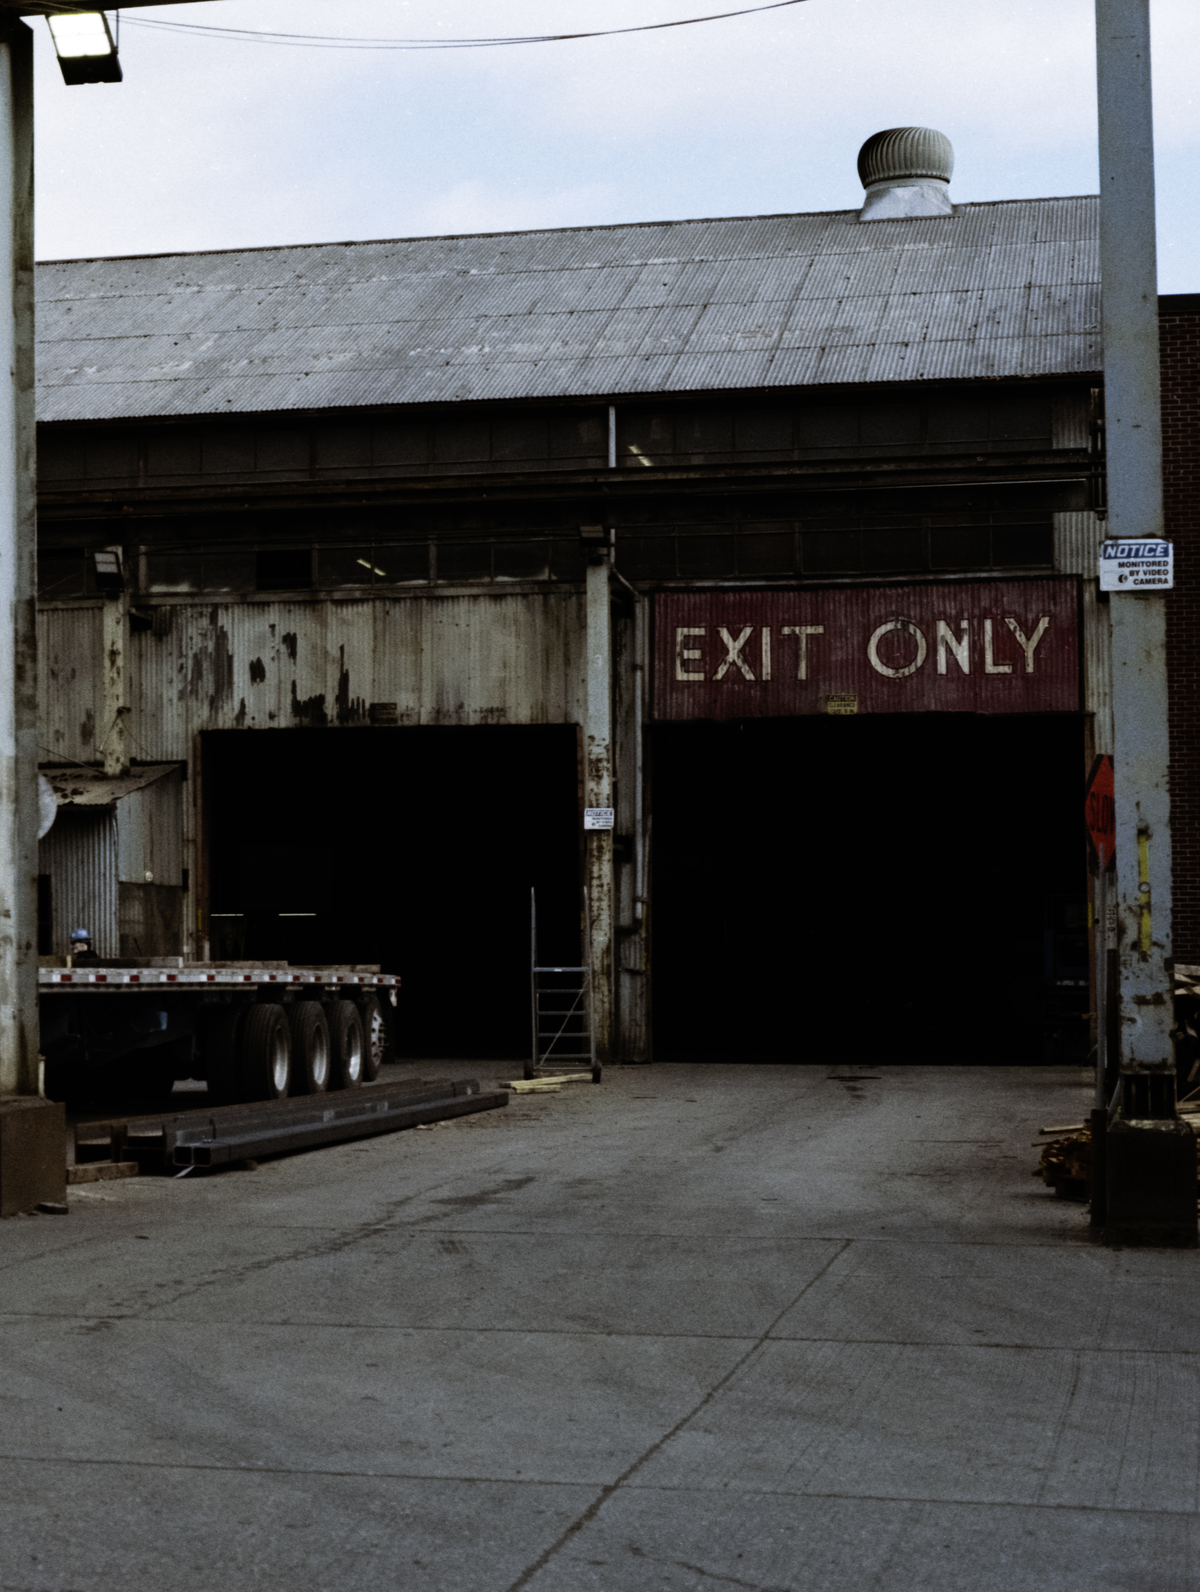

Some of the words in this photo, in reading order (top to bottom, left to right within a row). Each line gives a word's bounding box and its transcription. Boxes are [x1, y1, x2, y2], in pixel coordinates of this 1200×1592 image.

[1105, 543, 1167, 558] NOTICE
[1118, 560, 1169, 568] MONITORED
[1129, 569, 1140, 577] BY
[1142, 568, 1169, 576] VIDEO
[1133, 577, 1169, 586] CAMERA
[675, 623, 825, 682] EXIT
[867, 615, 1051, 679] ONLY
